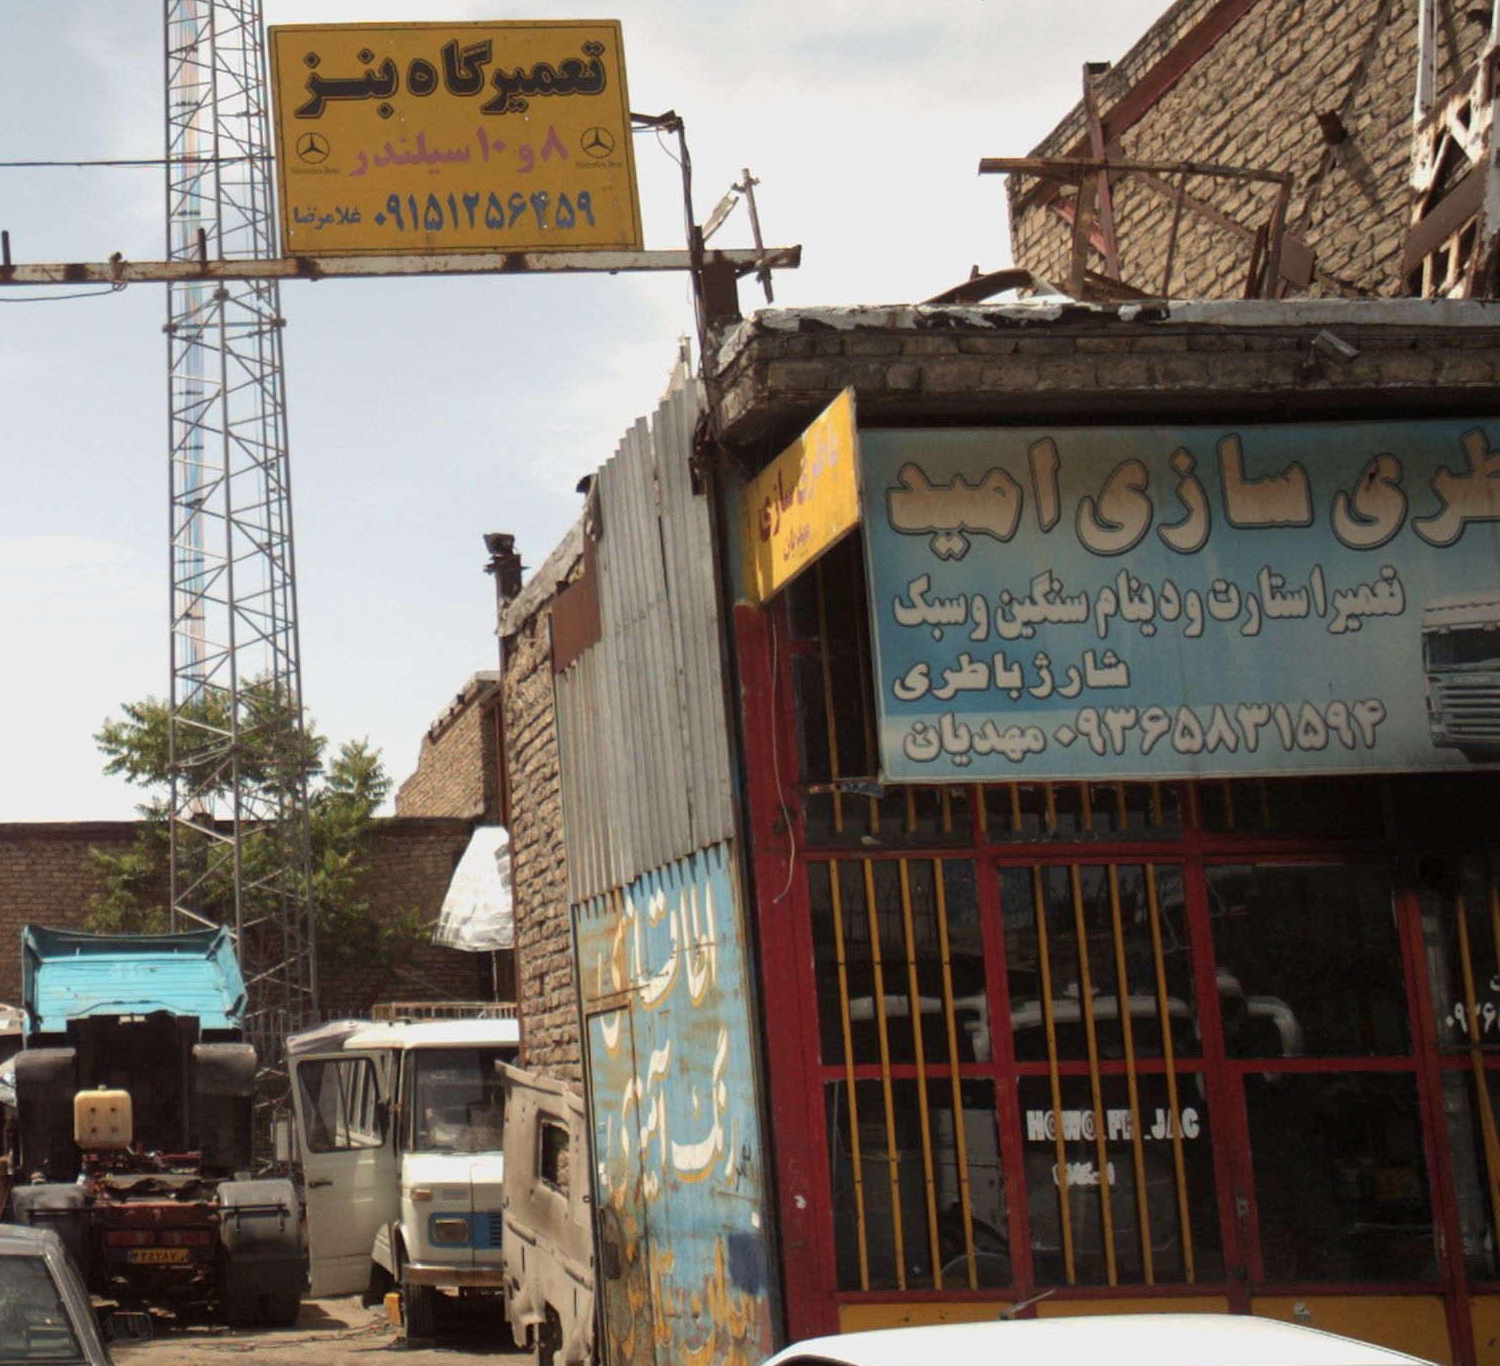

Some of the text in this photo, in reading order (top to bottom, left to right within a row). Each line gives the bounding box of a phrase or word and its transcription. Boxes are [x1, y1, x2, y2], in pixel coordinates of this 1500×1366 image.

[294, 38, 607, 119] تعمیرگاه بنز
[348, 130, 471, 177] سیلندر
[293, 188, 597, 233] ۰۹۱۵۱۲۵۶۴۵۹ غلامرضا
[886, 436, 1062, 560] امید
[1076, 433, 1315, 556] سازی
[892, 563, 1406, 642] تعمیر استارت و دینام سنگین و سبک
[892, 648, 1131, 701] شارژ باطری
[903, 697, 1387, 767] ۰۹۳۶۵۸۳۱۵۹۴ مهدیان
